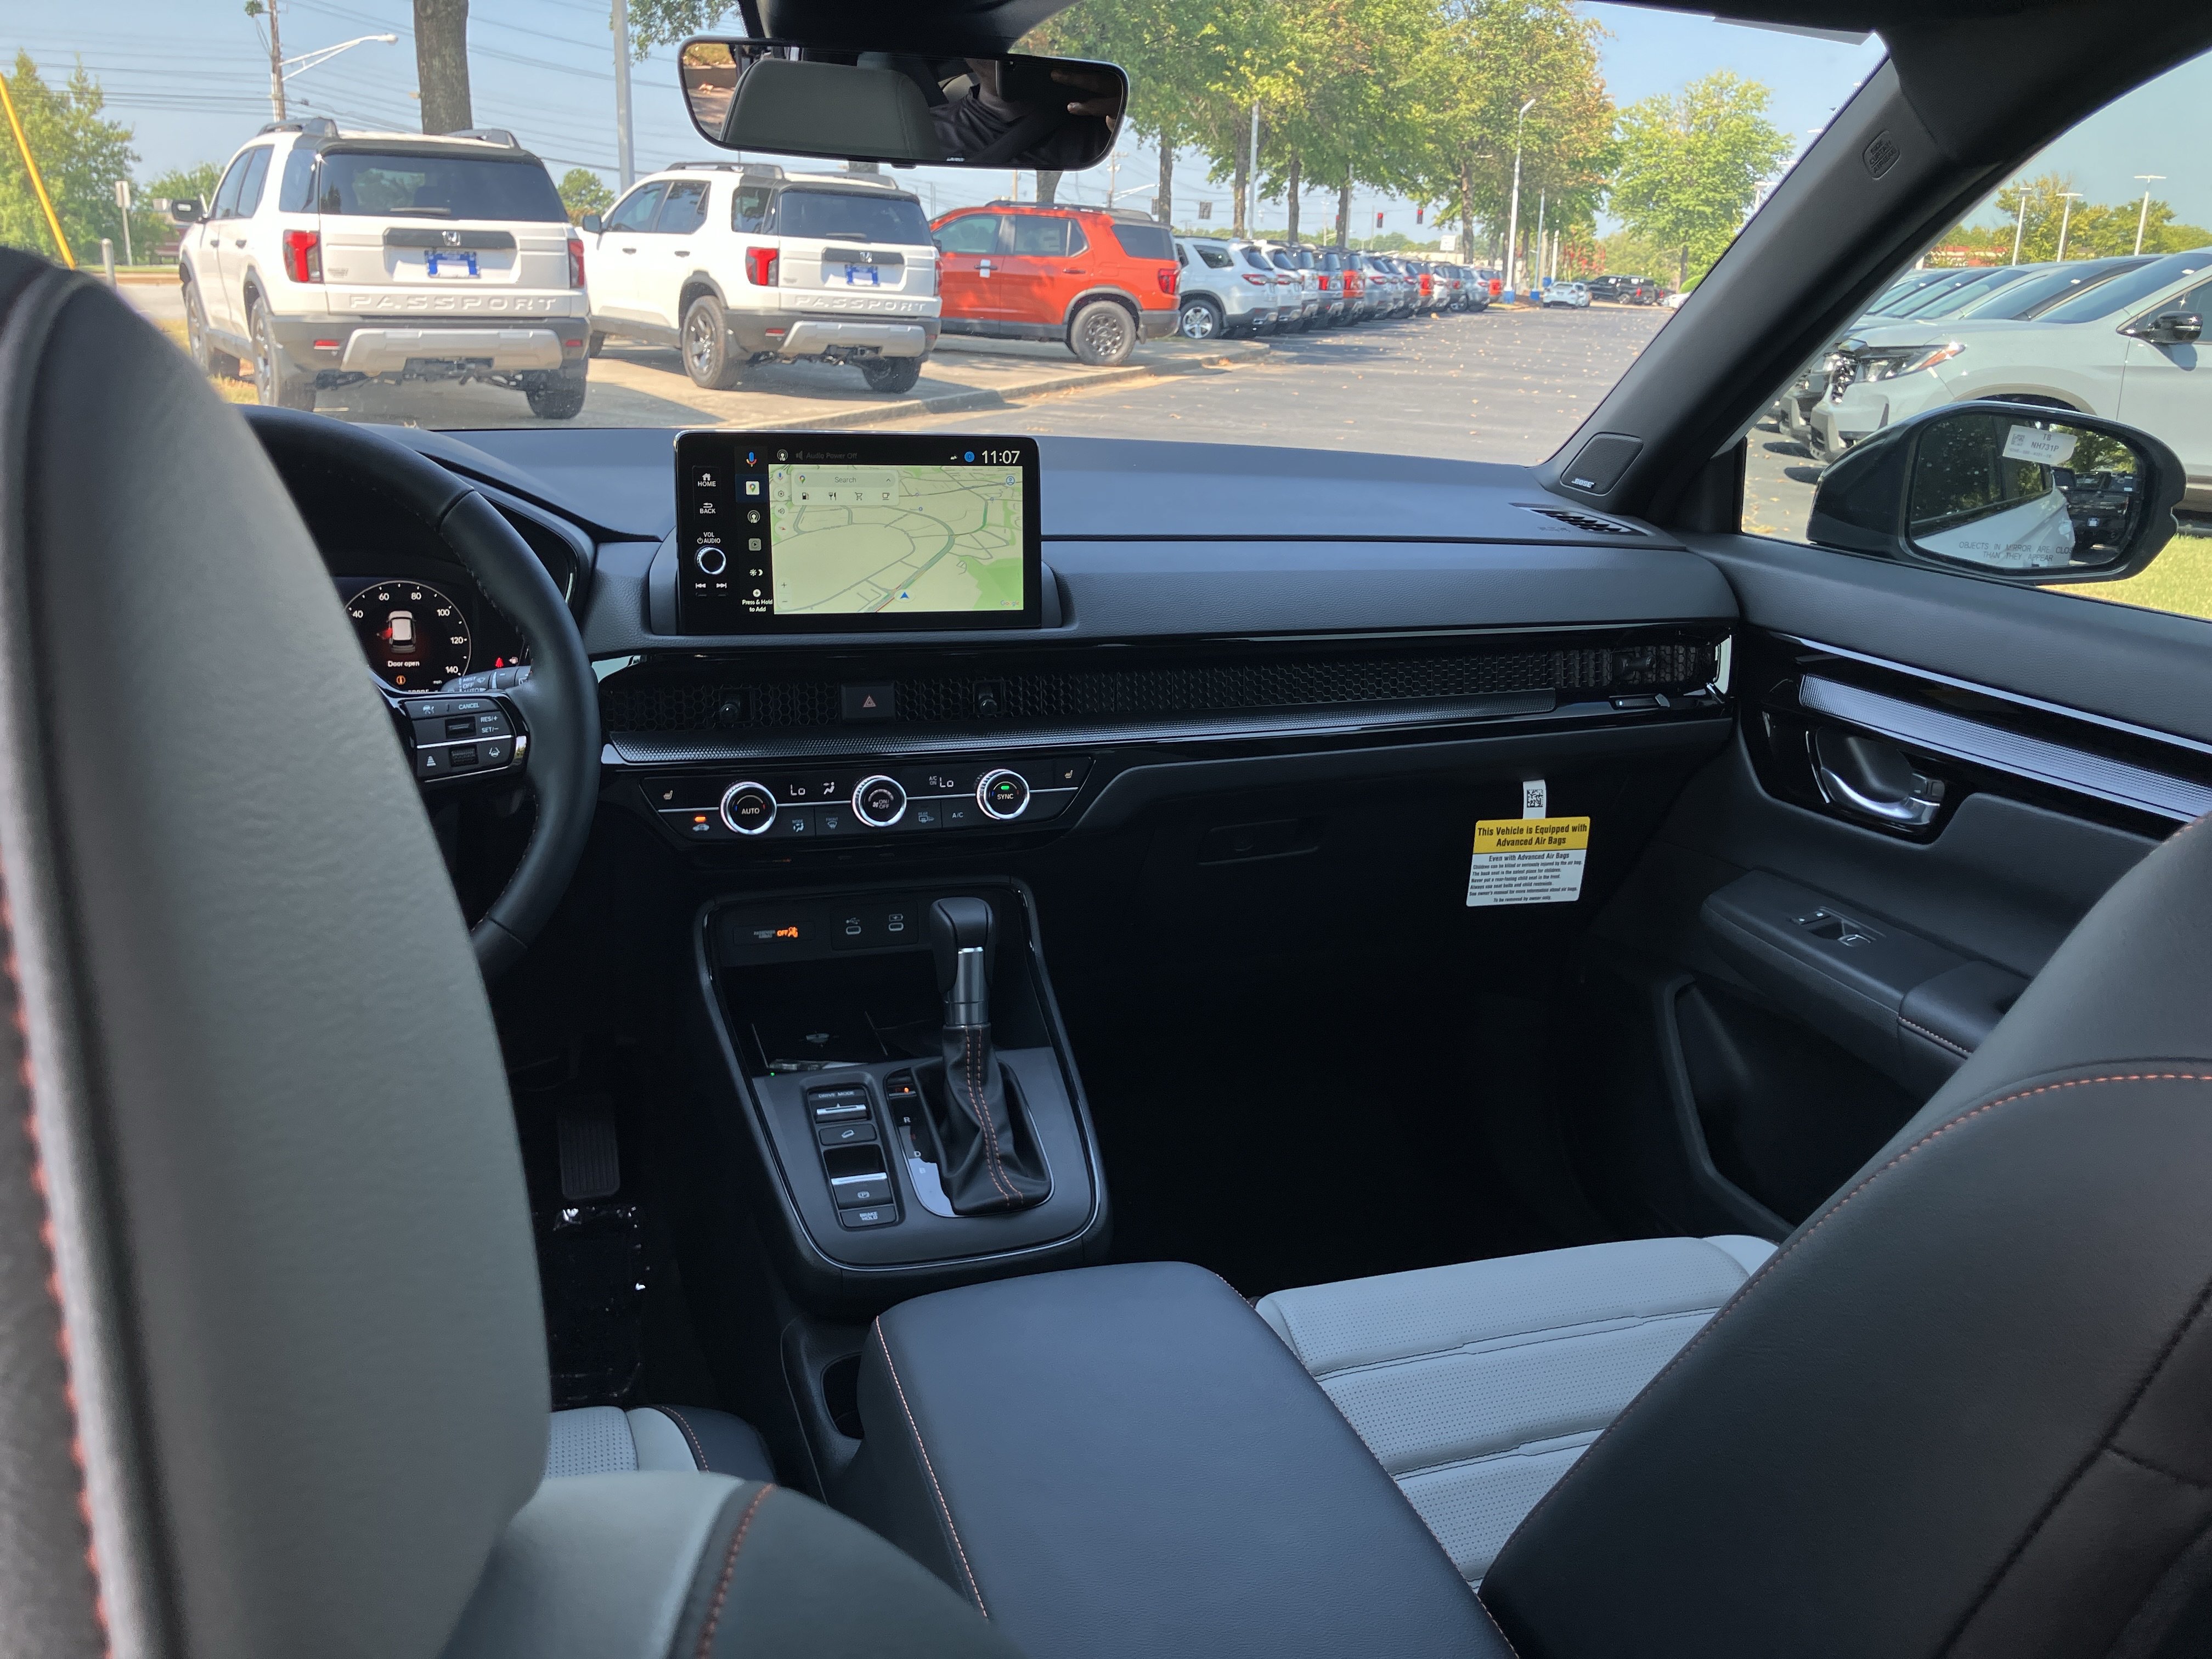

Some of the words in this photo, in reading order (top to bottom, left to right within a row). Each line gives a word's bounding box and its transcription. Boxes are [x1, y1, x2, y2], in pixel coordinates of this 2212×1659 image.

[349, 294, 556, 311] PASSPORT
[795, 296, 926, 312] PASSPORT
[2031, 442, 2059, 452] NH731P
[982, 450, 1020, 464] 11:07
[1571, 478, 1594, 488] BOSE
[1959, 541, 1989, 550] OBJECTS
[2005, 544, 2032, 552] MIRROR
[379, 592, 390, 601] 60
[939, 777, 954, 788] Lo
[790, 784, 805, 796] Lo
[1478, 827, 1493, 836] This
[1496, 826, 1523, 835] Vehicle
[1535, 825, 1569, 835] Equipped
[1572, 823, 1587, 832] with
[1497, 837, 1532, 847] Advanced
[1534, 836, 1545, 845] Air
[1548, 836, 1566, 846] Bags
